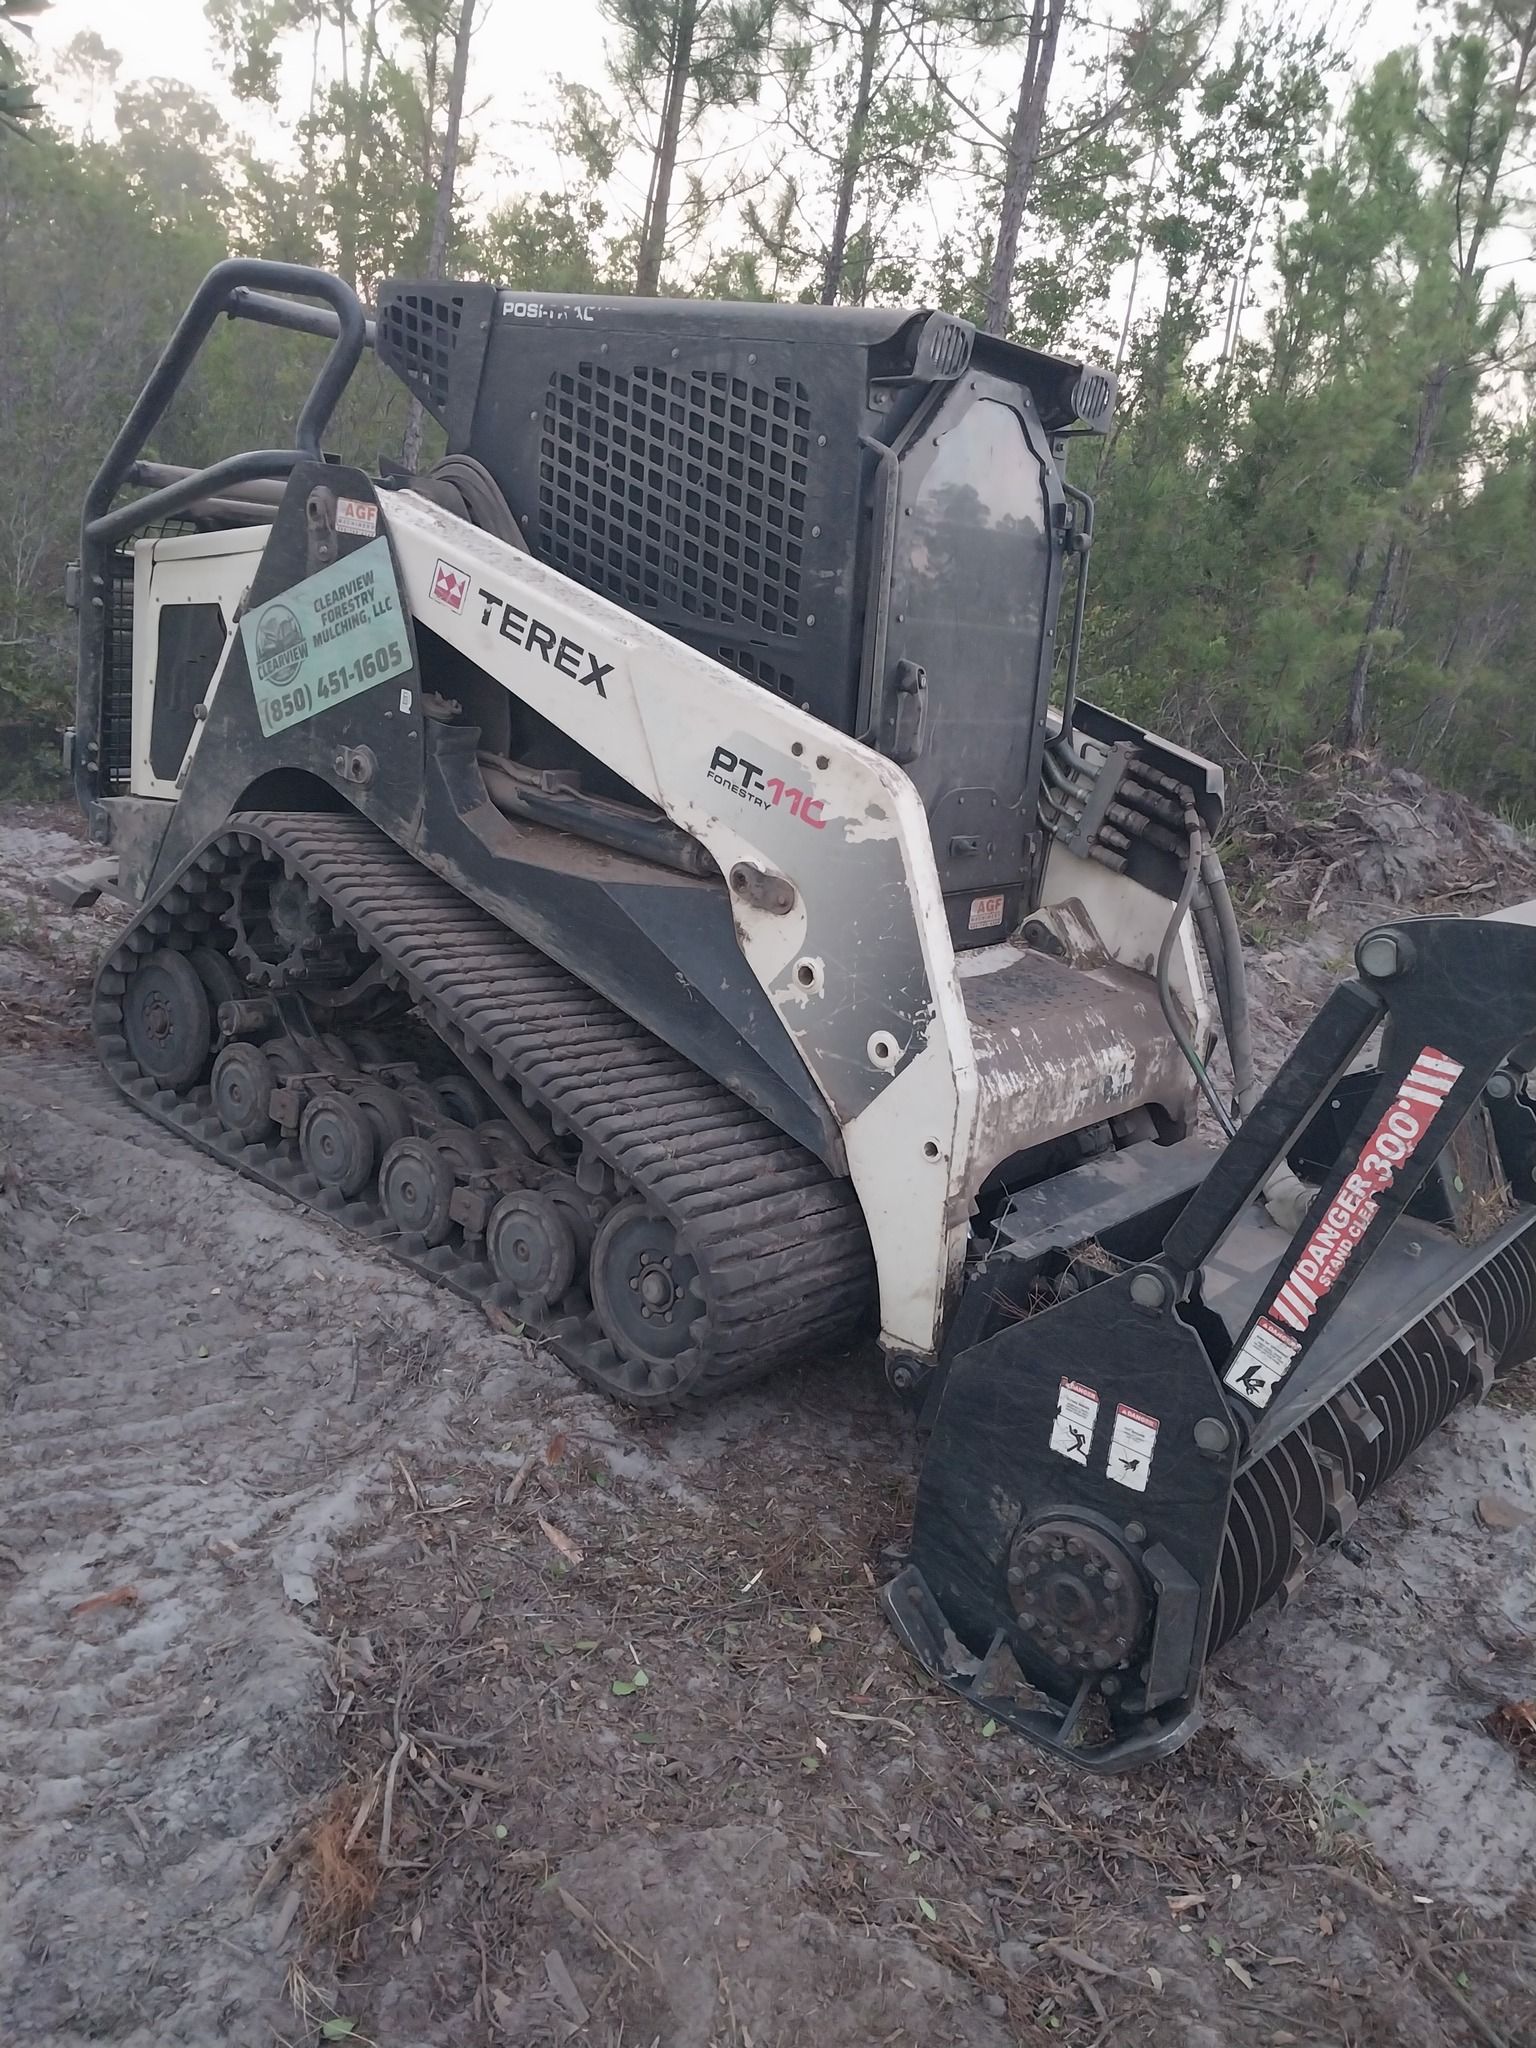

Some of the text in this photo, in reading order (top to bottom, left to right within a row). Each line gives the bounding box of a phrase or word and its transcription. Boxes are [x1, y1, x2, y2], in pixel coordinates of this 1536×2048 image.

[345, 502, 376, 521] AGF
[313, 570, 375, 613] CLEARVIEW
[321, 587, 375, 626] FORESTRY
[312, 596, 393, 648] MULCHING, LLC
[478, 588, 615, 699] TEREX
[257, 642, 309, 681] CLEARVIEW
[264, 641, 403, 730] (850) 451-1605
[977, 897, 1002, 914] AGF
[1298, 1099, 1419, 1282] DANGER 300'
[1319, 1190, 1378, 1287] STAND CLEA
